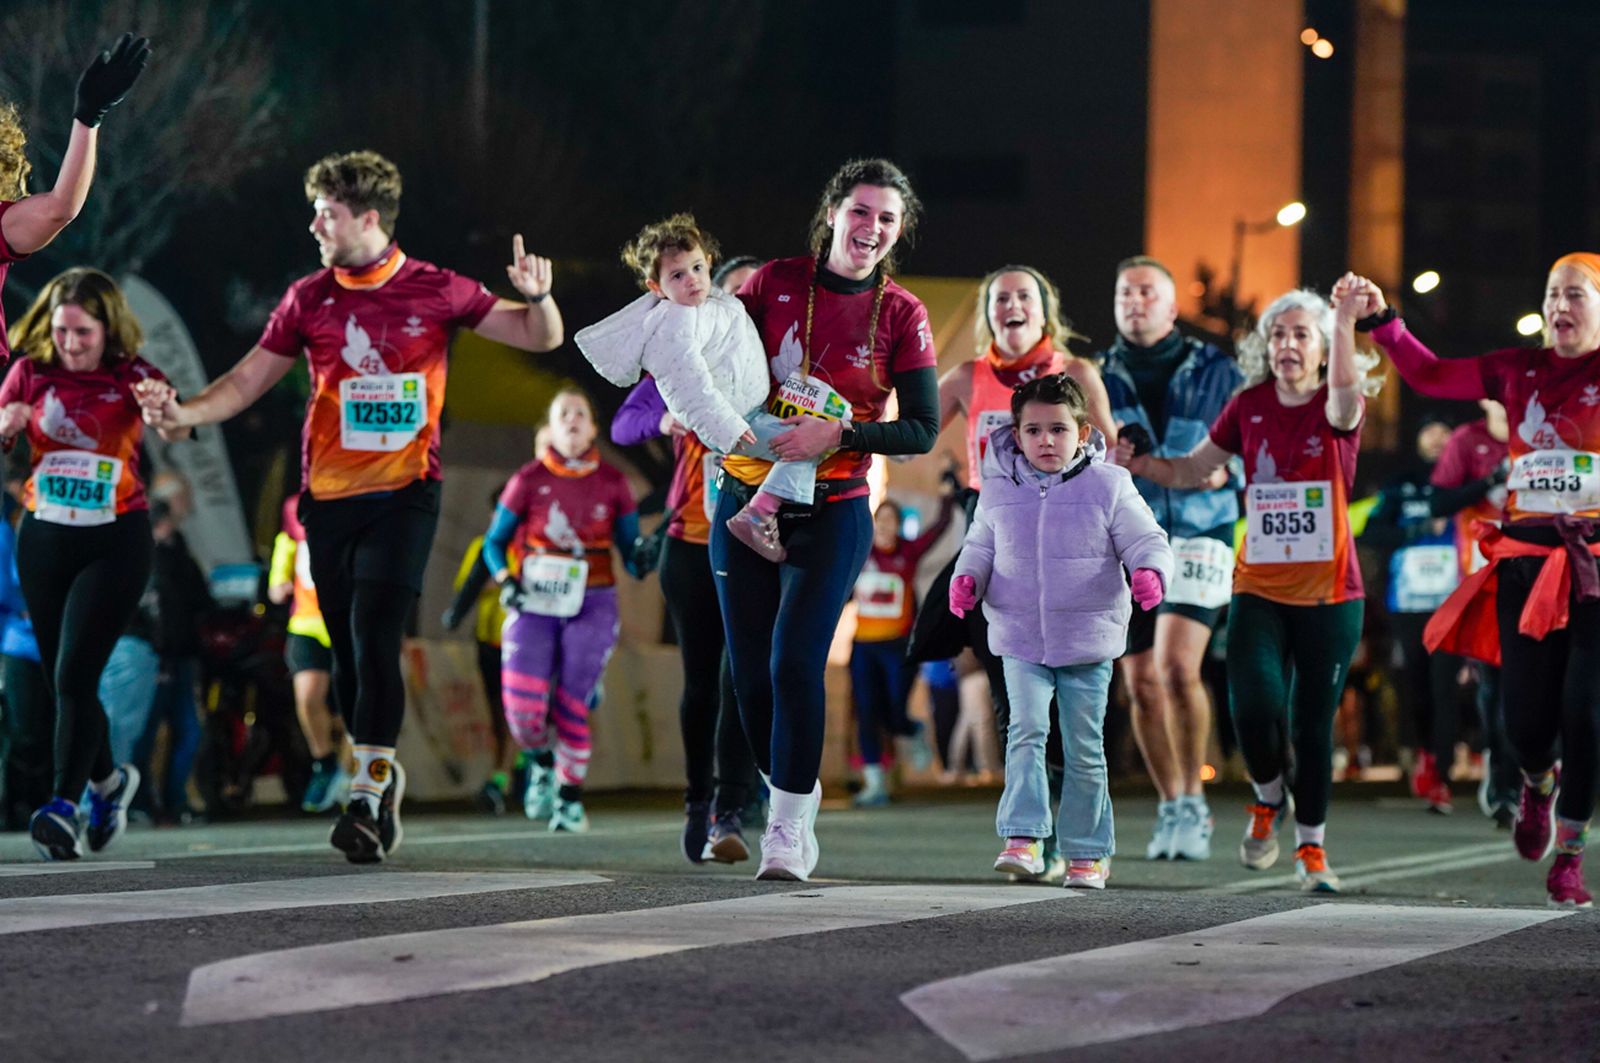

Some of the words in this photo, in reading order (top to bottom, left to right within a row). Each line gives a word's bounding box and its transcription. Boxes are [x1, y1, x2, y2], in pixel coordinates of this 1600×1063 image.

[359, 355, 380, 375] 43
[782, 379, 807, 394] OCHE
[807, 387, 820, 398] DE
[352, 402, 416, 425] 12532
[1531, 428, 1555, 449] 43
[47, 477, 105, 503] 13754
[1262, 511, 1316, 535] 6353
